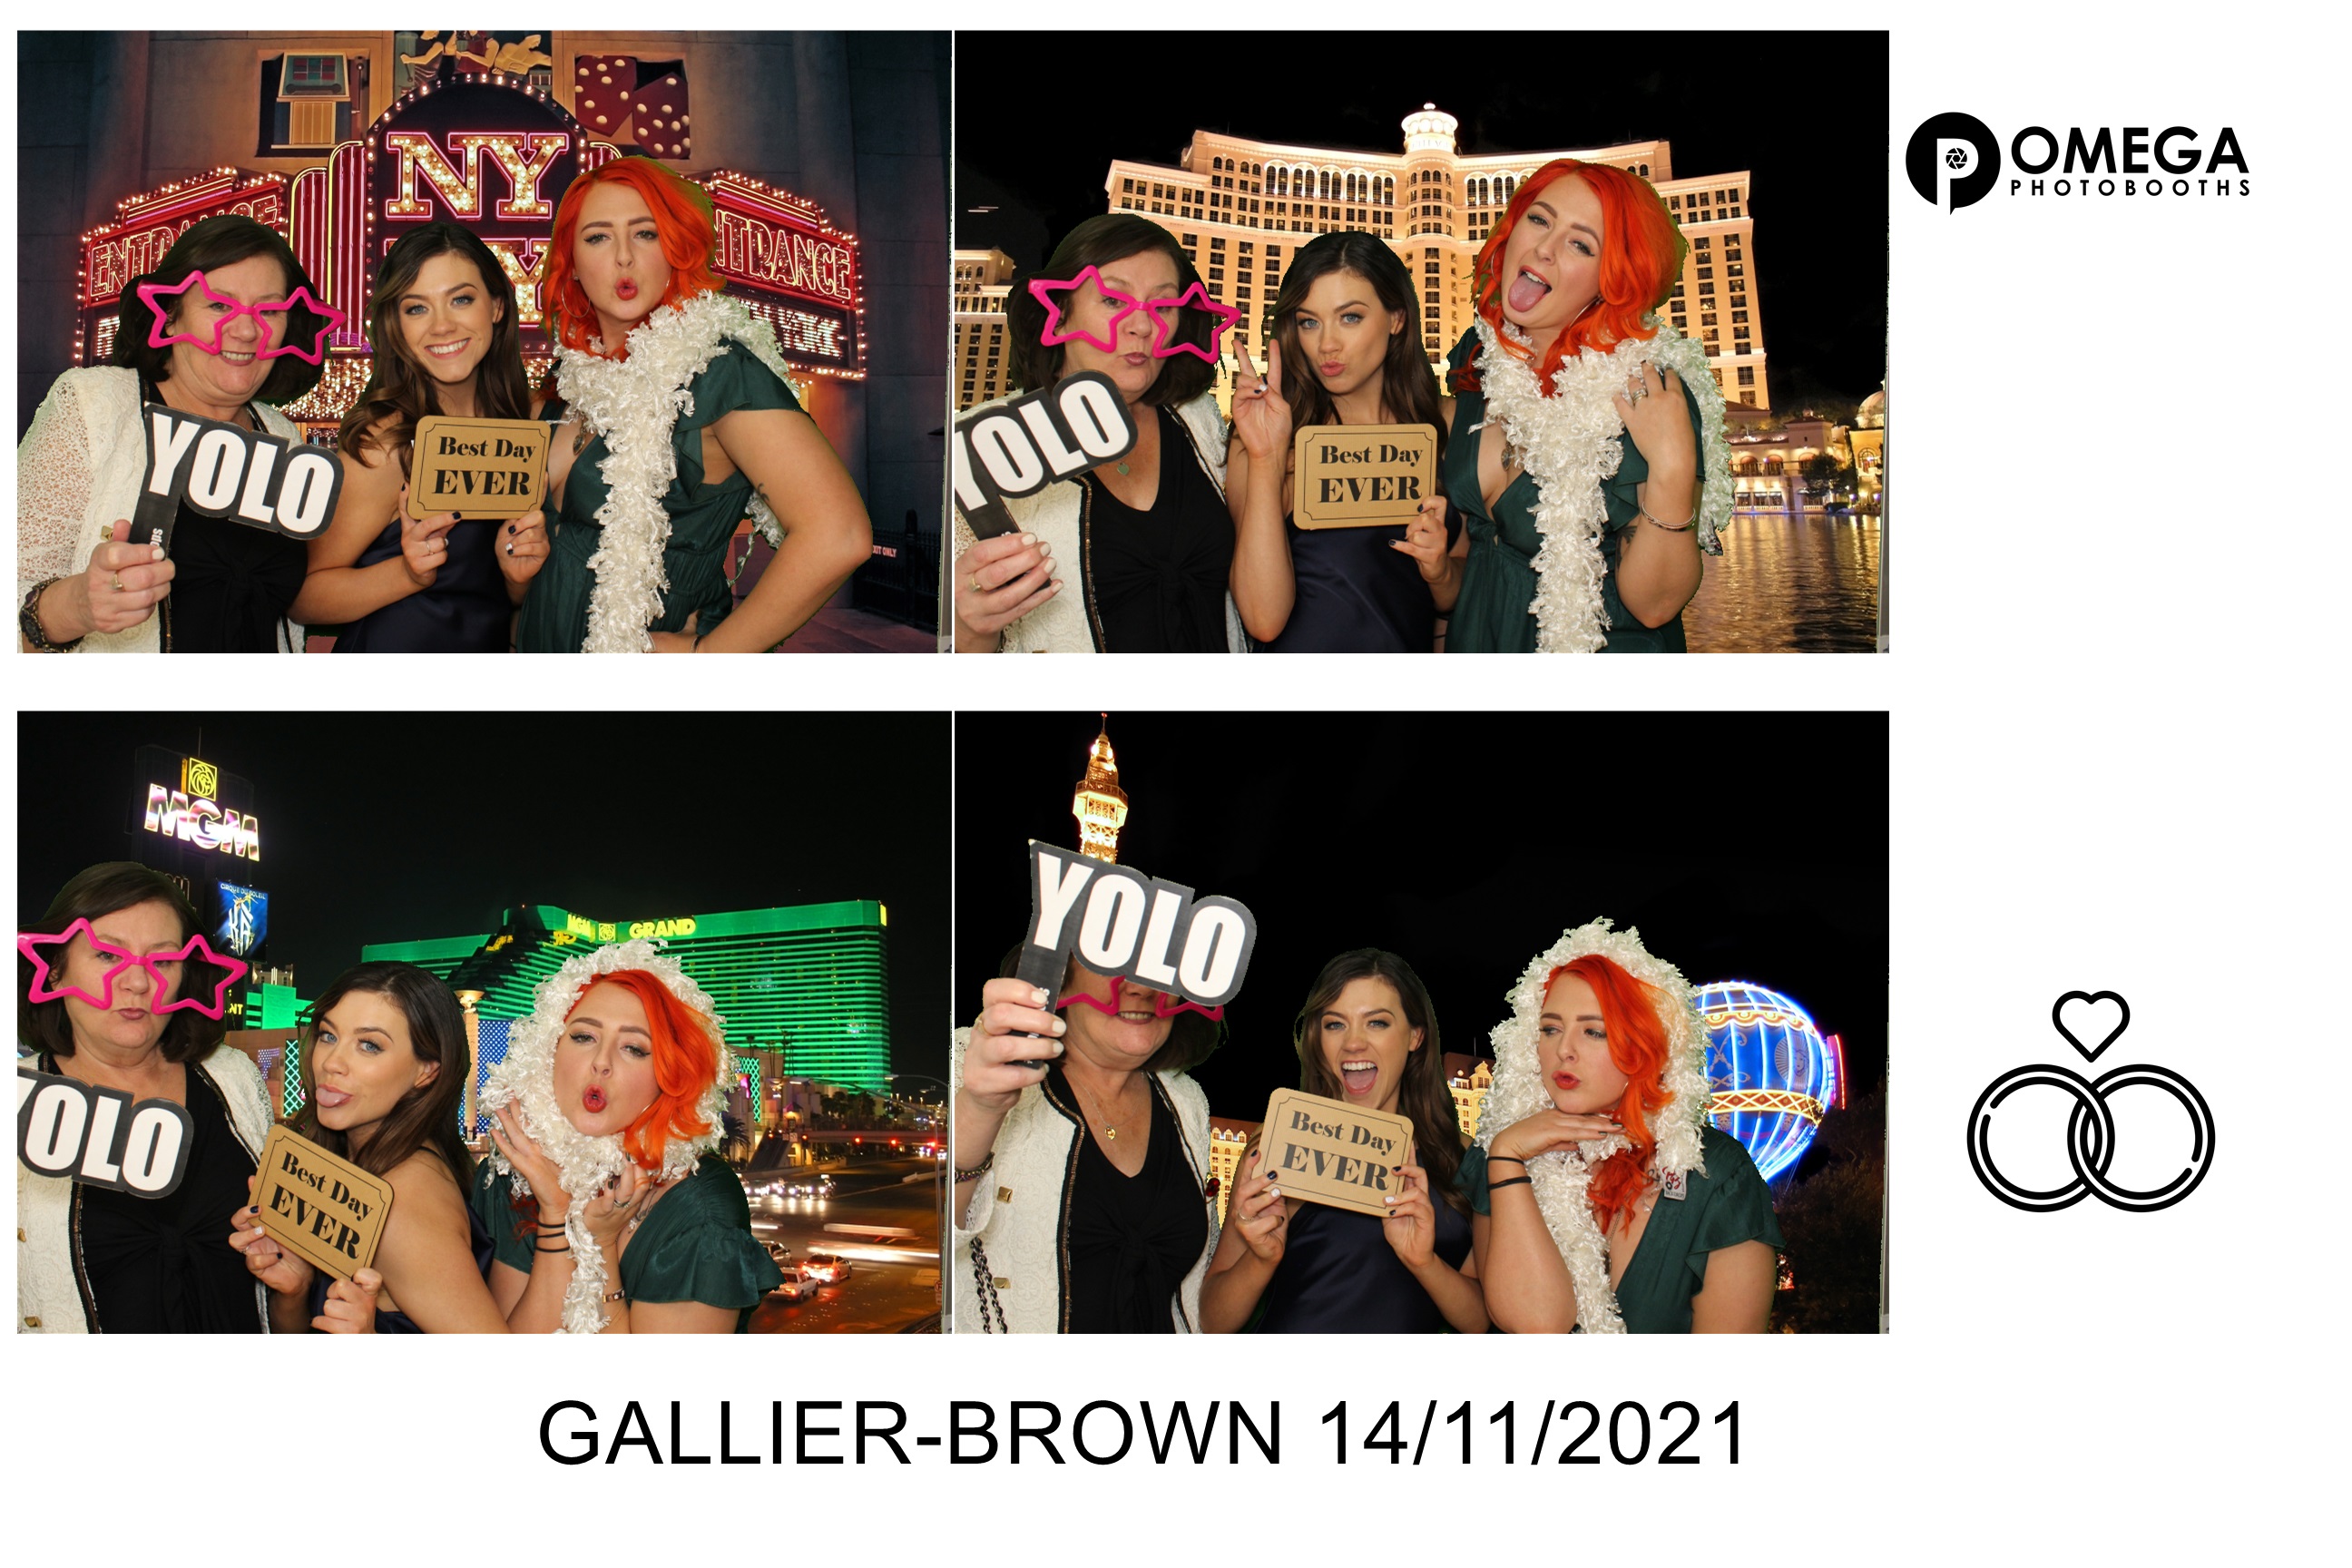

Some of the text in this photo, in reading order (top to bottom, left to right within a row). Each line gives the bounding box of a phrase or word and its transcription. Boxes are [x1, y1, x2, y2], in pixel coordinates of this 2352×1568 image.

[386, 132, 569, 220] NY
[714, 209, 851, 299] NTRANCE
[148, 413, 335, 534] YOLO
[432, 467, 532, 496] EVER
[438, 436, 536, 463] Best Day
[1319, 443, 1423, 468] Best Day
[1318, 475, 1423, 505] EVER
[144, 783, 260, 862] MGM
[629, 917, 697, 939] GRAND
[1033, 851, 1247, 998] YOLO
[17, 1078, 183, 1192] OLO
[1279, 1142, 1391, 1191] EVER
[1289, 1110, 1397, 1156] Best Day
[268, 1182, 362, 1259] EVER
[280, 1150, 374, 1221] Best Day
